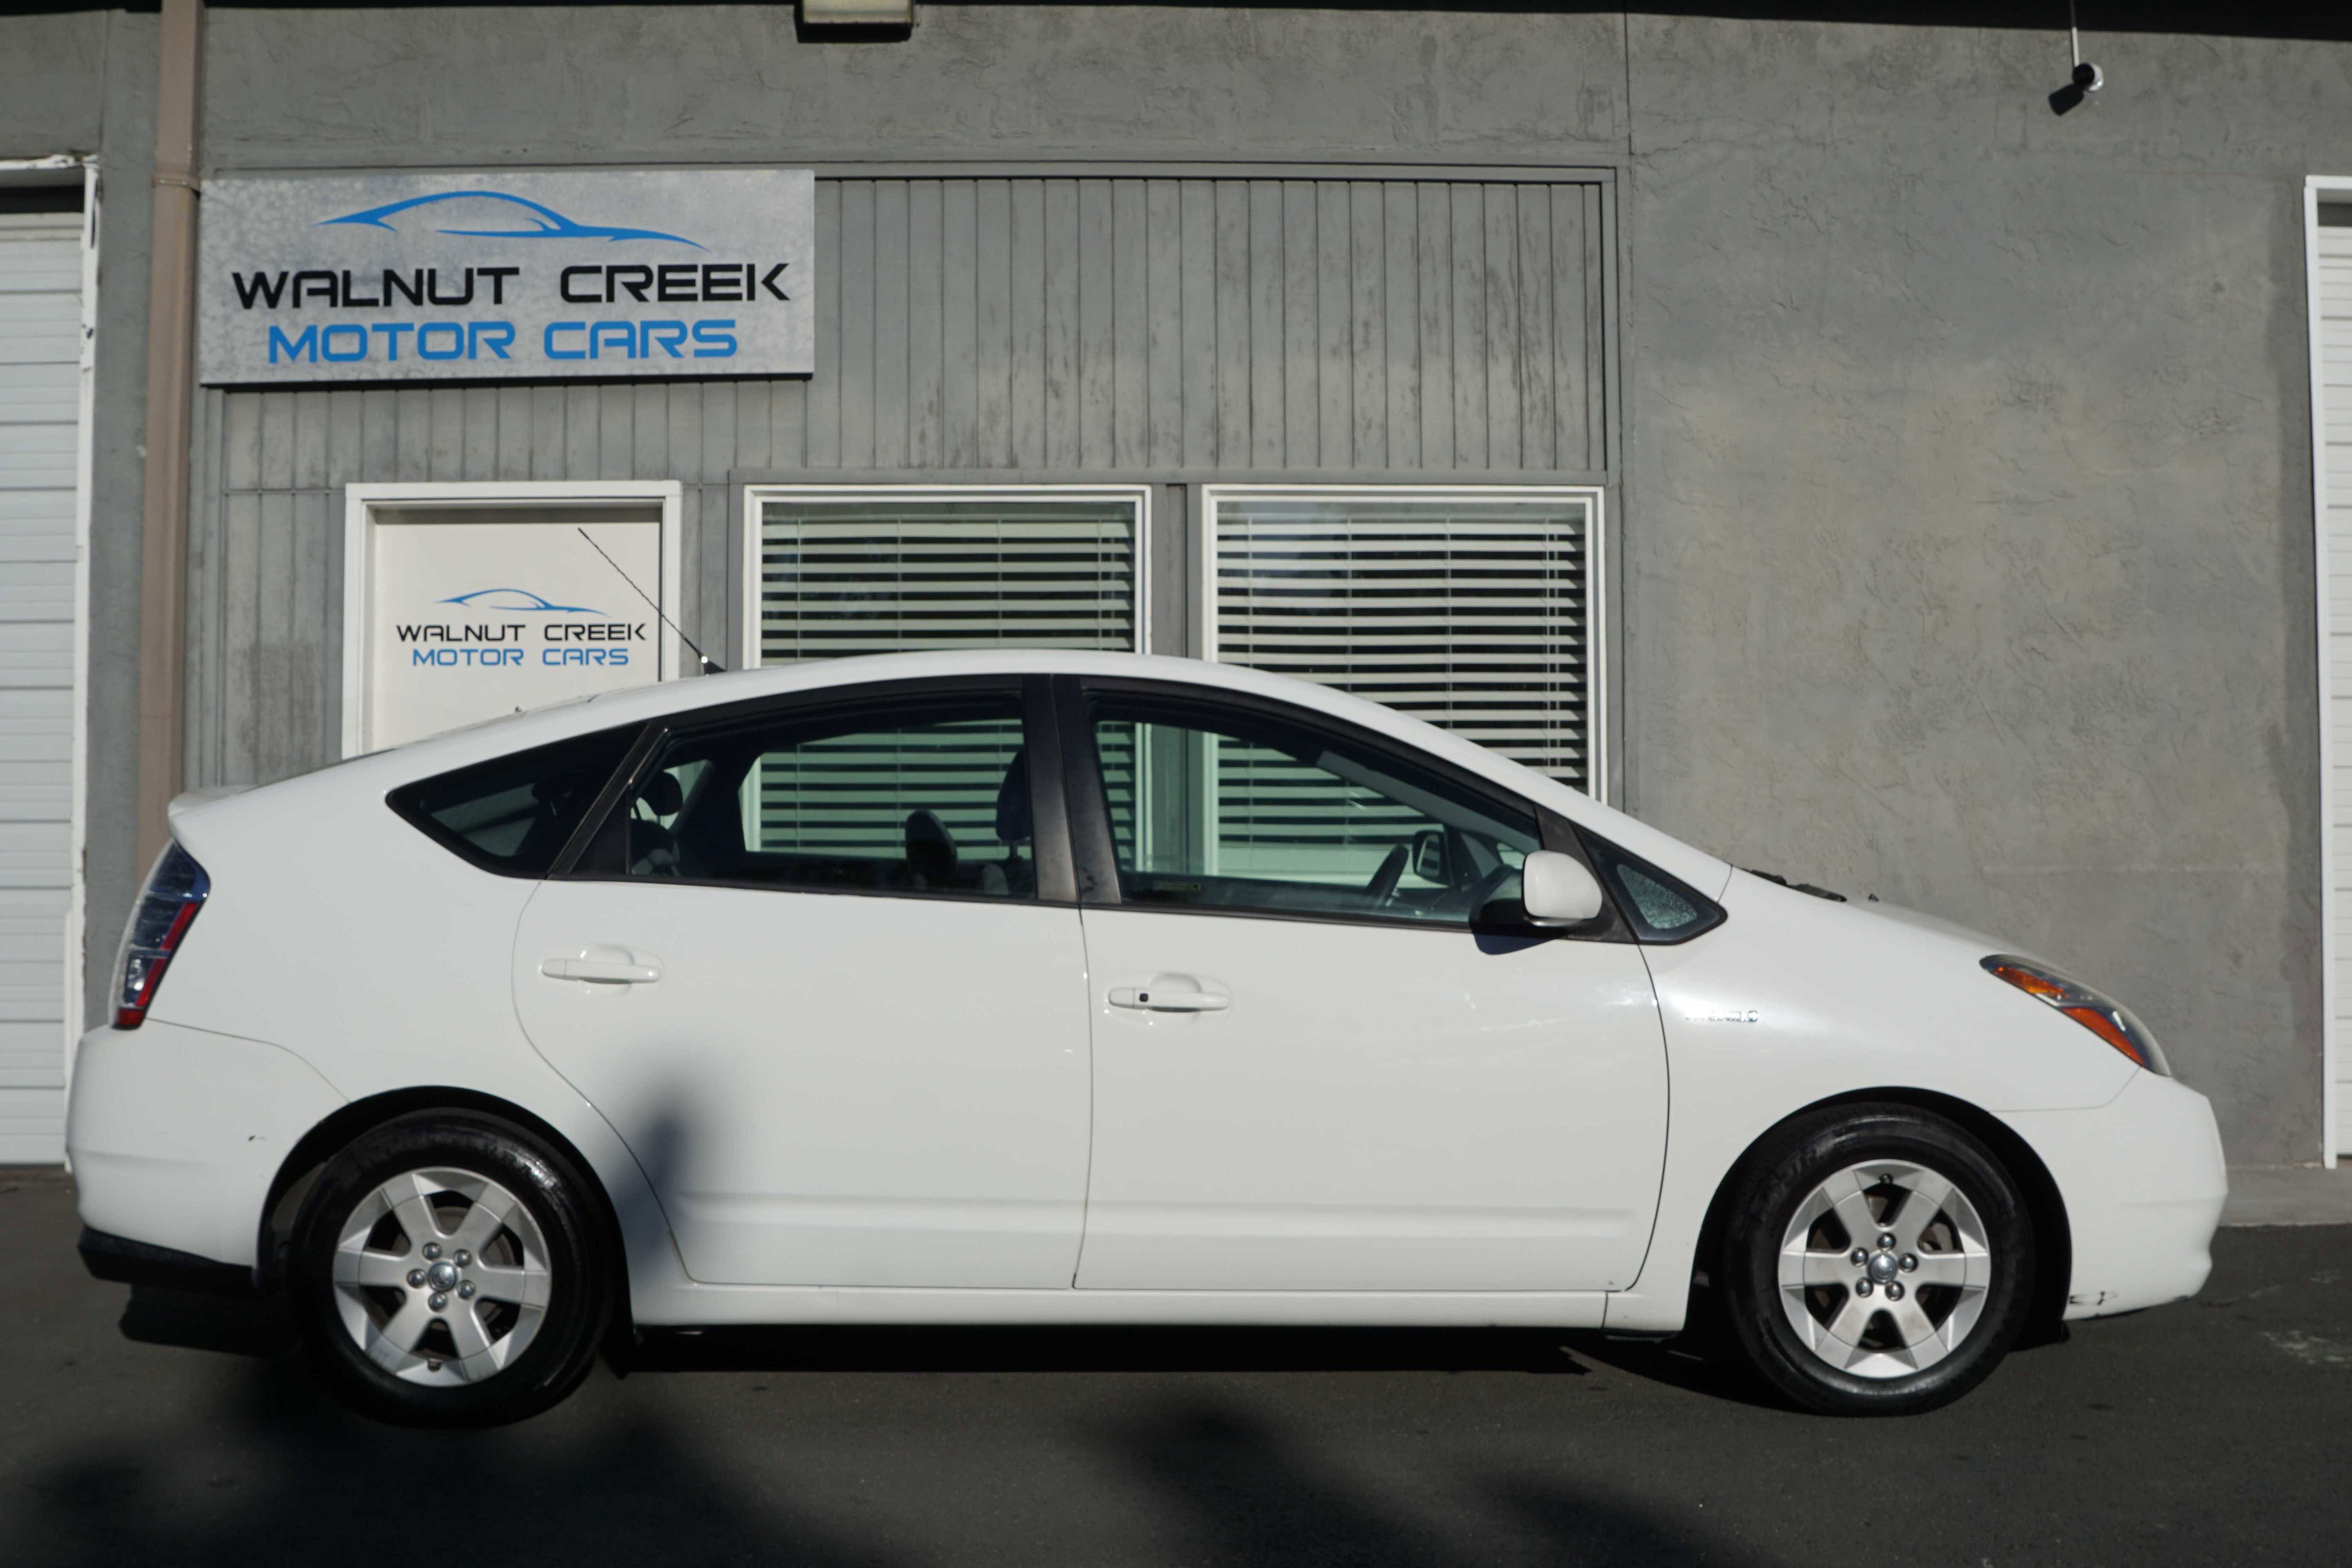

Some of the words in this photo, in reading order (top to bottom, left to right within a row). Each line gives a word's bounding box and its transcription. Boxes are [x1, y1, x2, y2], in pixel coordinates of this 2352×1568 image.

[232, 267, 520, 310] WALNUT
[560, 263, 790, 303] CREEK
[268, 321, 516, 364] MOTOR
[543, 319, 737, 360] CARS
[396, 625, 526, 641] WALNUT
[544, 624, 646, 640] CREEK
[413, 648, 524, 666] MOTOR
[542, 648, 628, 665] CARS
